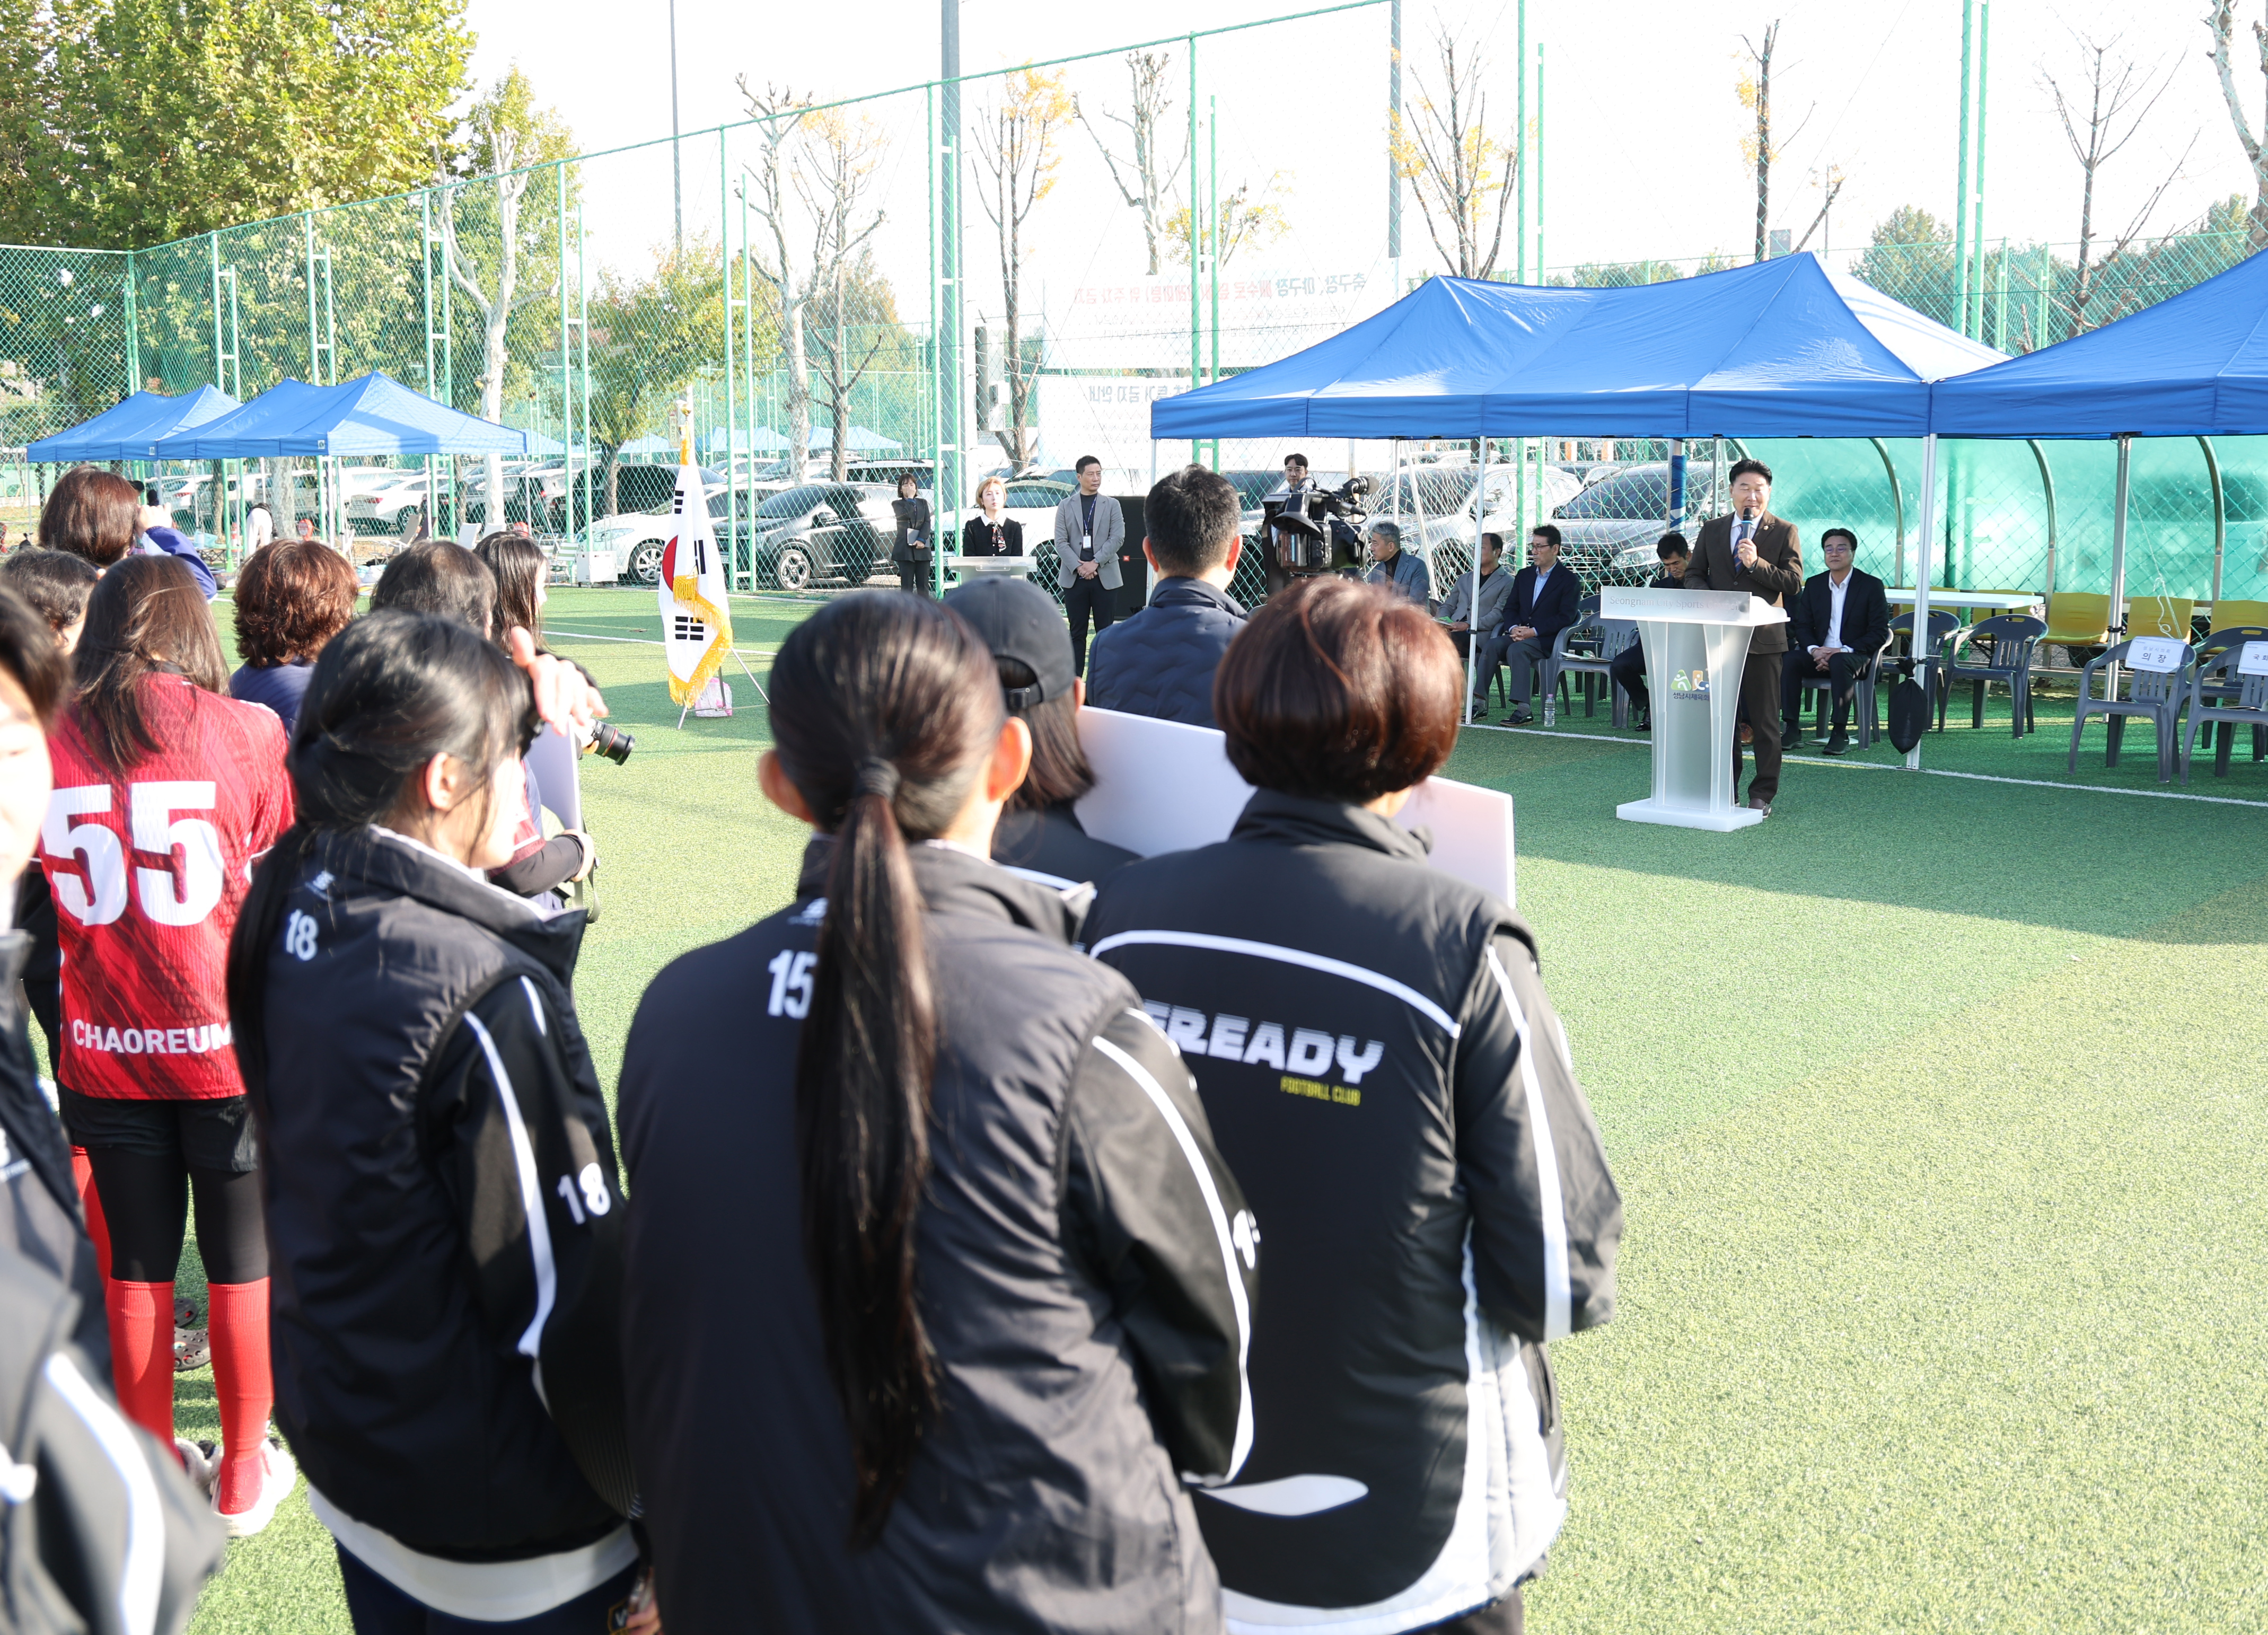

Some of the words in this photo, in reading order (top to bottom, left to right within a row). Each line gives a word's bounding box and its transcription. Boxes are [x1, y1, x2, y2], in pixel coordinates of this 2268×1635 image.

[1610, 596, 1654, 608] Seongnam
[1657, 598, 1674, 609] City
[1676, 600, 1704, 609] Sports
[1673, 692, 1710, 701] 성남시체육회
[41, 781, 224, 927] 55
[285, 908, 319, 961] 18
[768, 949, 819, 1019] 15
[73, 1018, 232, 1054] CHAOREUM
[1280, 1075, 1331, 1101] FOOTBALL
[1331, 1085, 1361, 1107] CLUB
[556, 1162, 611, 1226] 18
